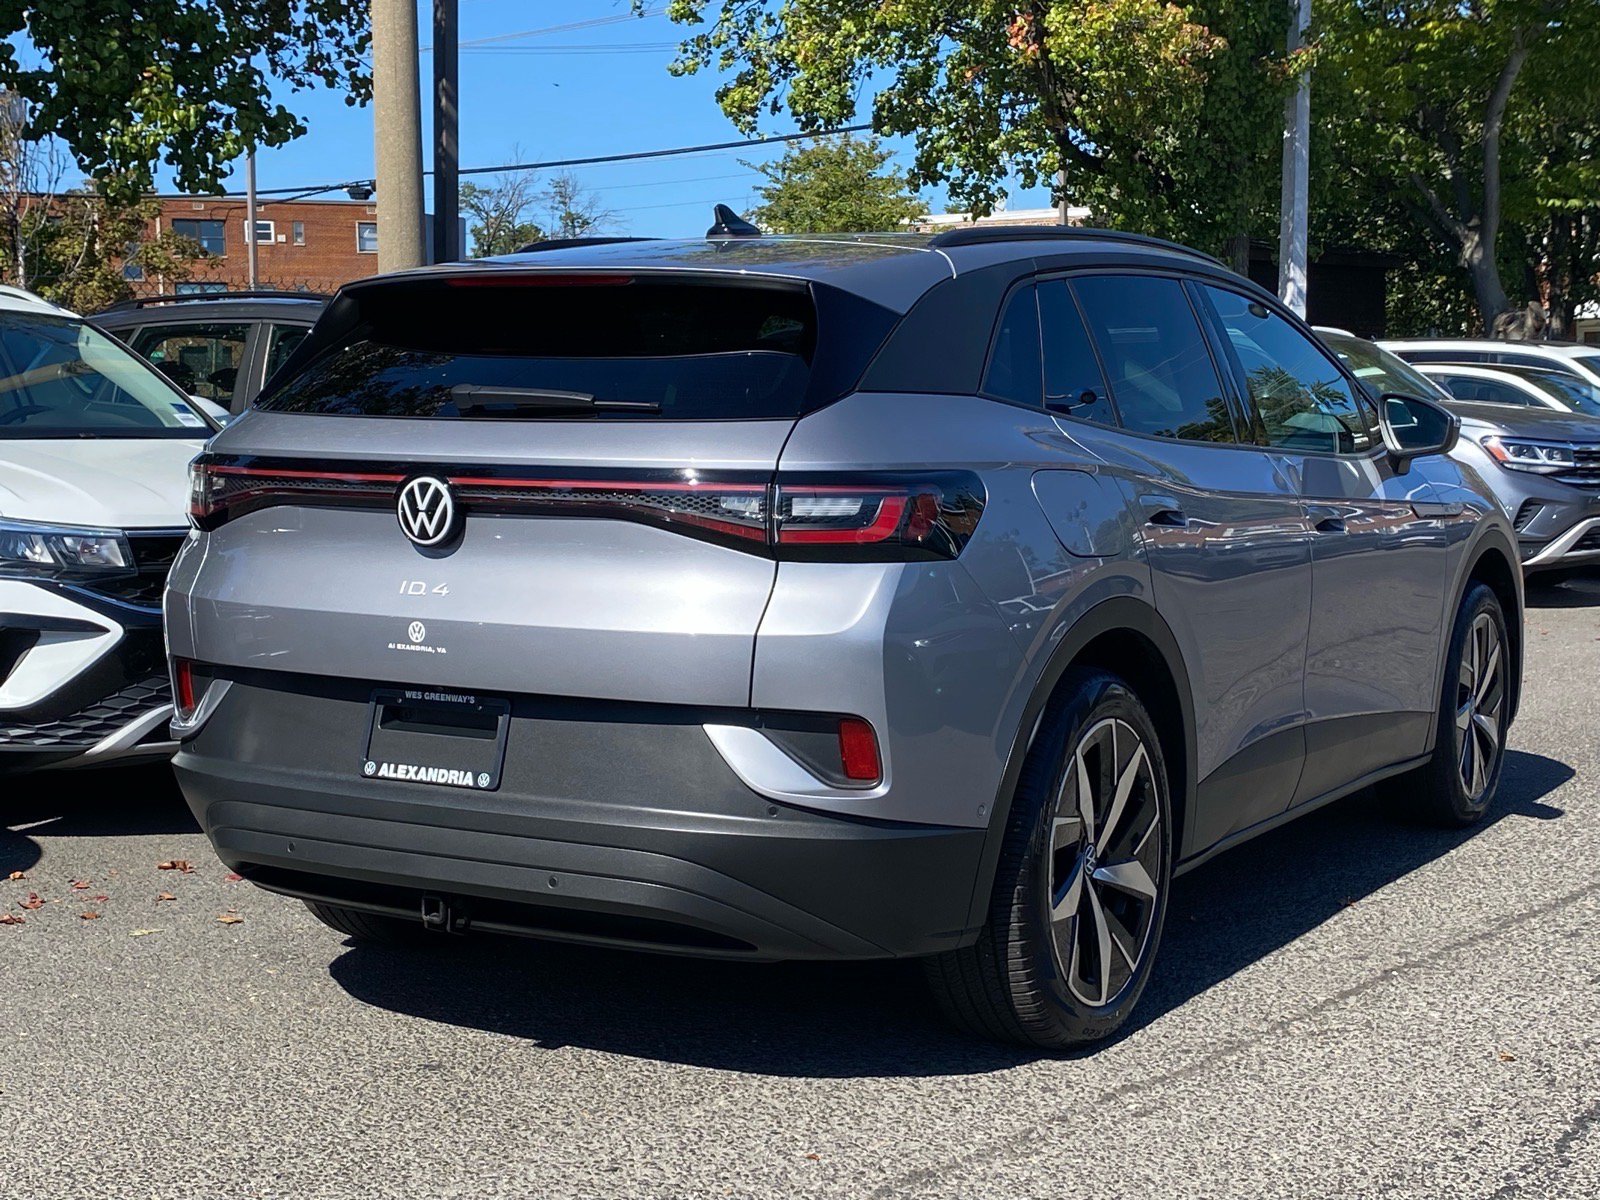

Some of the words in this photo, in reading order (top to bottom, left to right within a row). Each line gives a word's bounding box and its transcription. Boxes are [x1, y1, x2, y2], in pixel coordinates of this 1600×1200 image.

[405, 690, 422, 699] WES
[424, 692, 475, 704] GREENWAY'S
[378, 763, 474, 786] ALEXANDRIA
